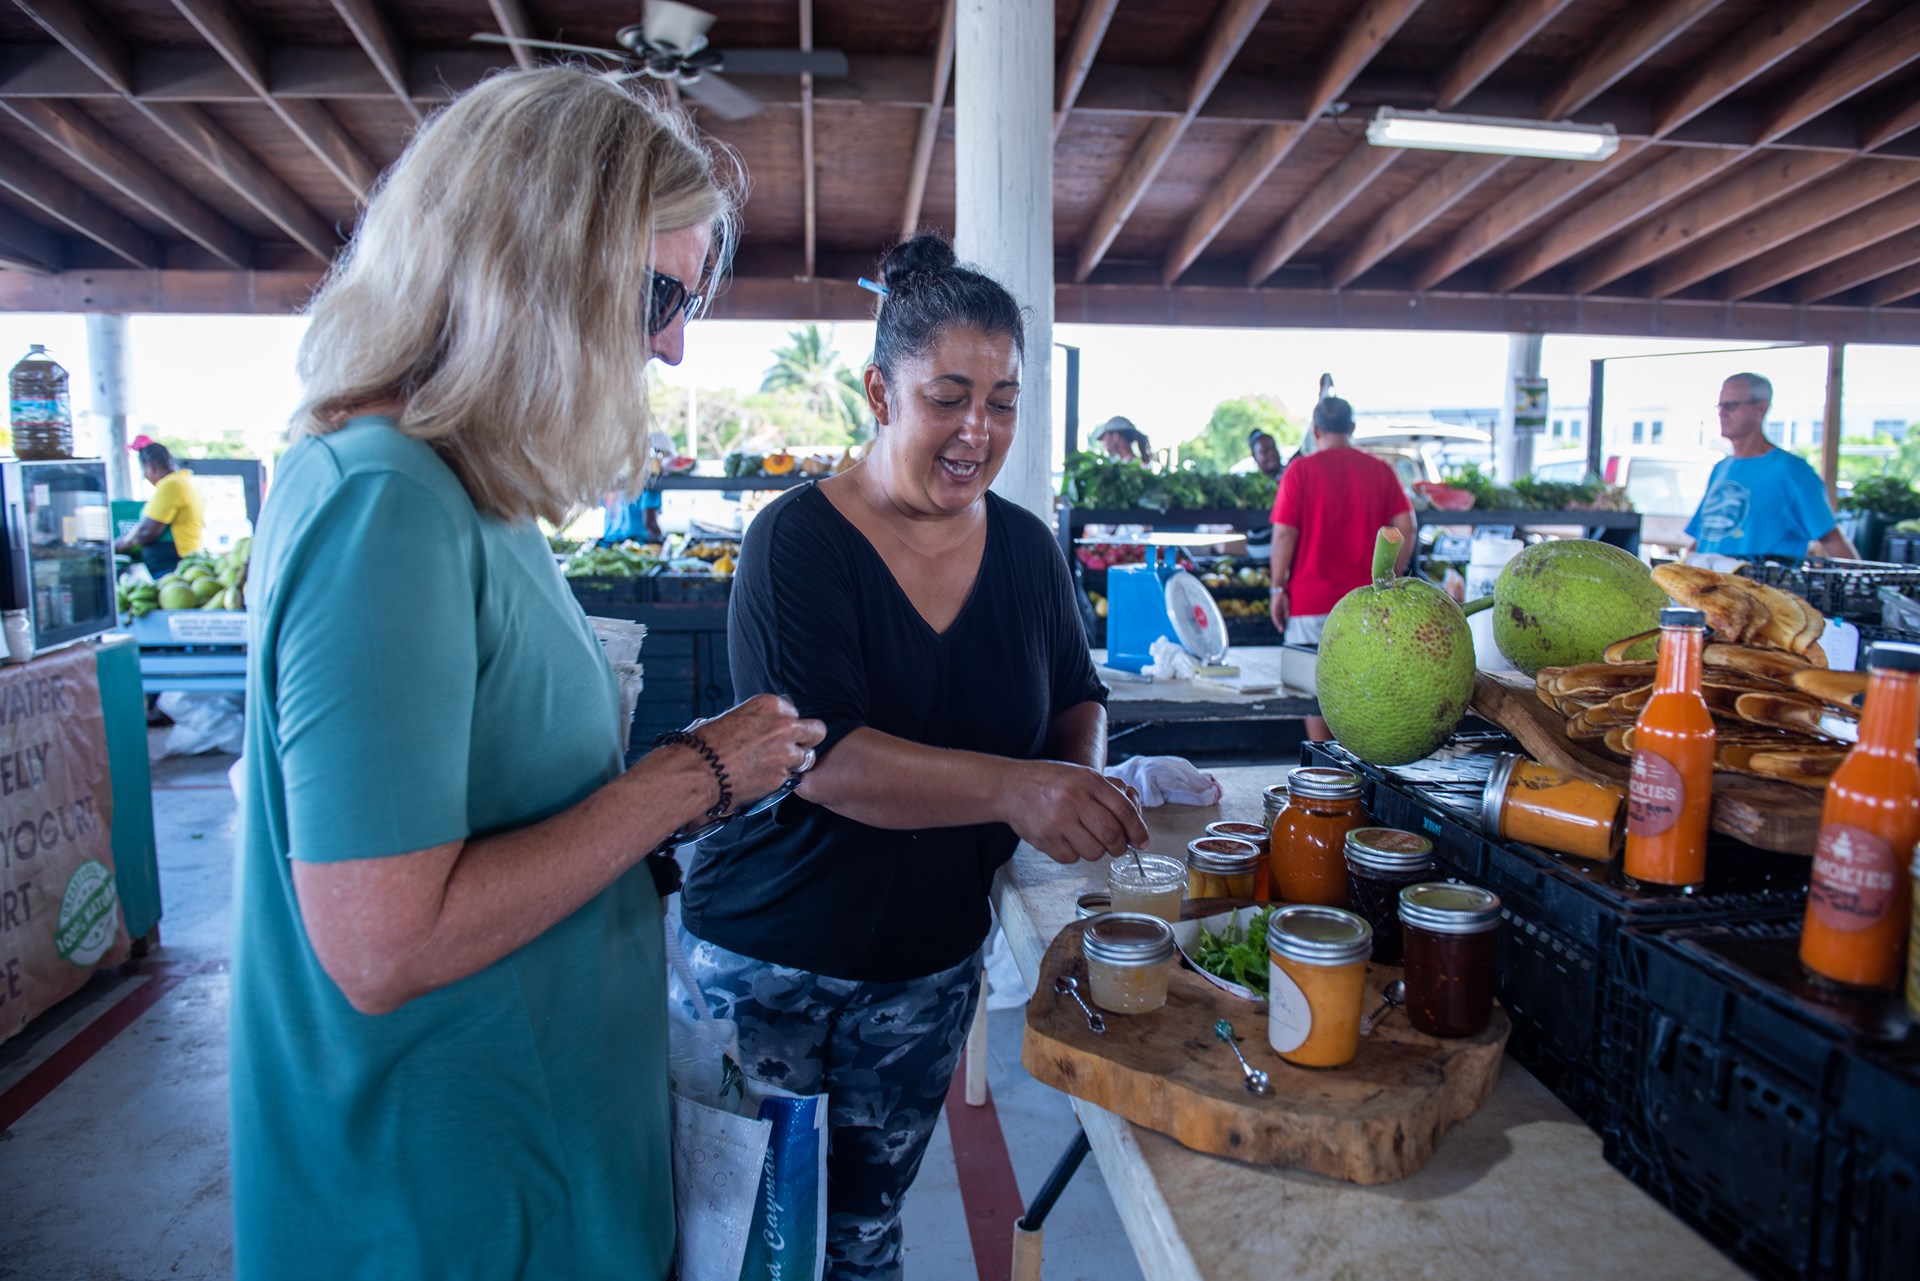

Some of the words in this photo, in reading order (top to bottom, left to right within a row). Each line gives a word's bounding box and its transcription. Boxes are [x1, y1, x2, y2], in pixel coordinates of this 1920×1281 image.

[0, 795, 93, 868] YOGURT
[56, 922, 86, 953] 100%
[763, 1145, 785, 1251] Cayman
